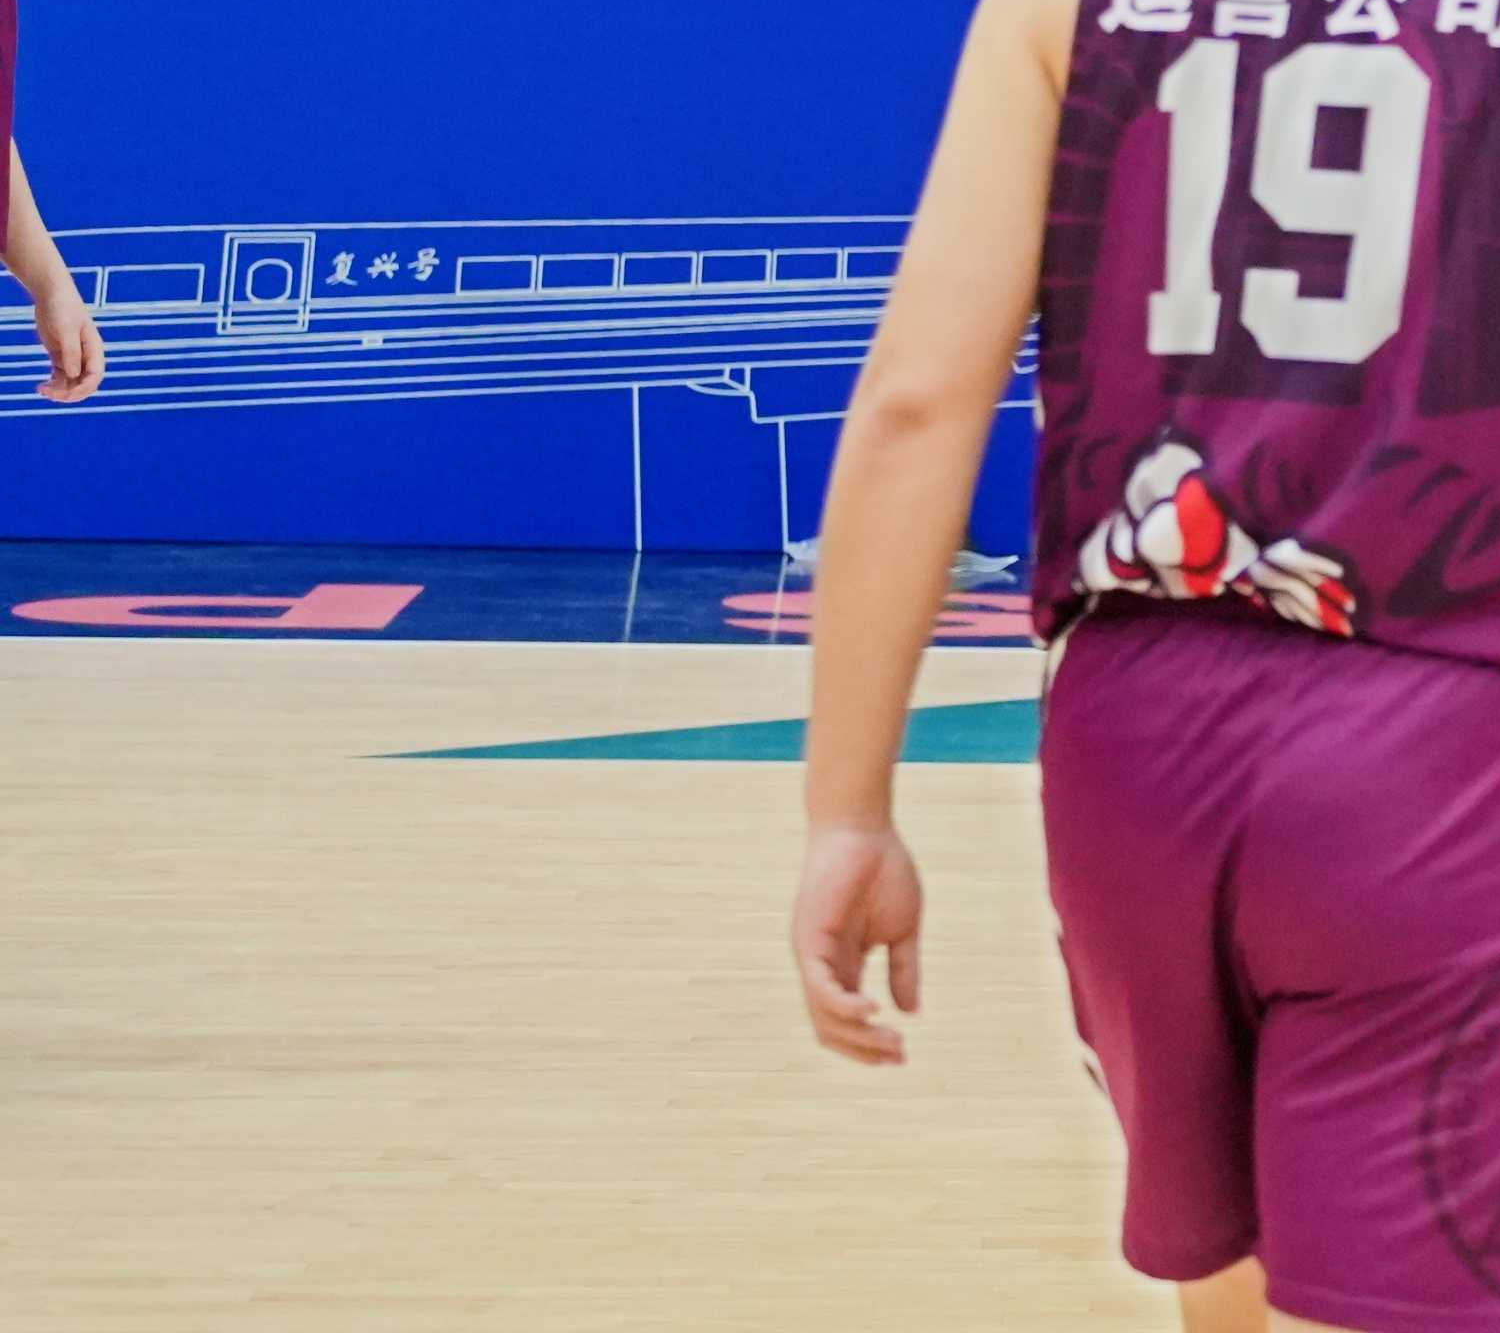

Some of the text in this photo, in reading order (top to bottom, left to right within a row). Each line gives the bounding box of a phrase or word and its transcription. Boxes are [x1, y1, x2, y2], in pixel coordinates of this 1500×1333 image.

[326, 246, 442, 287] 复兴号
[1146, 38, 1432, 364] 19
